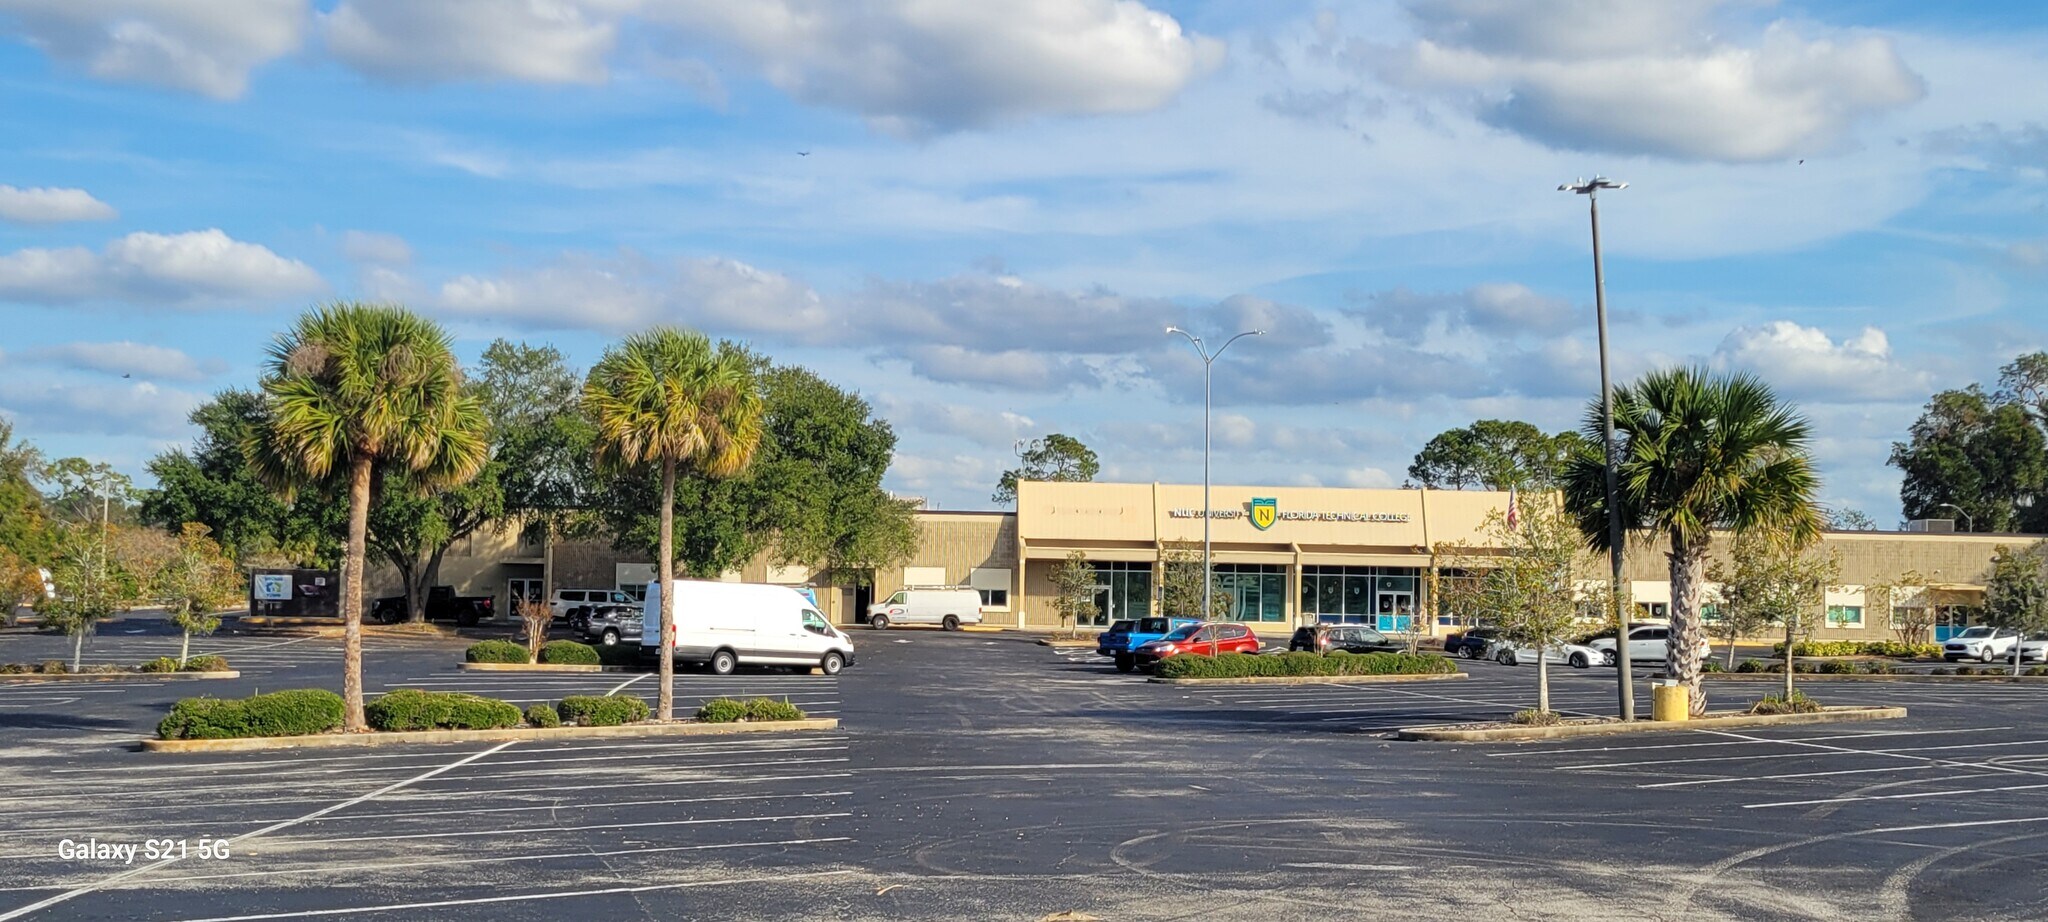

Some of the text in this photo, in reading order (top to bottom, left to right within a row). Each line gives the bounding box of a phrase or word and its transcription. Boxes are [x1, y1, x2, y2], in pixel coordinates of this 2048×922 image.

[1173, 507, 1195, 517] NUC
[1259, 509, 1270, 521] N
[1282, 510, 1319, 520] FLORIDA
[1322, 511, 1370, 521] TECHNICAL
